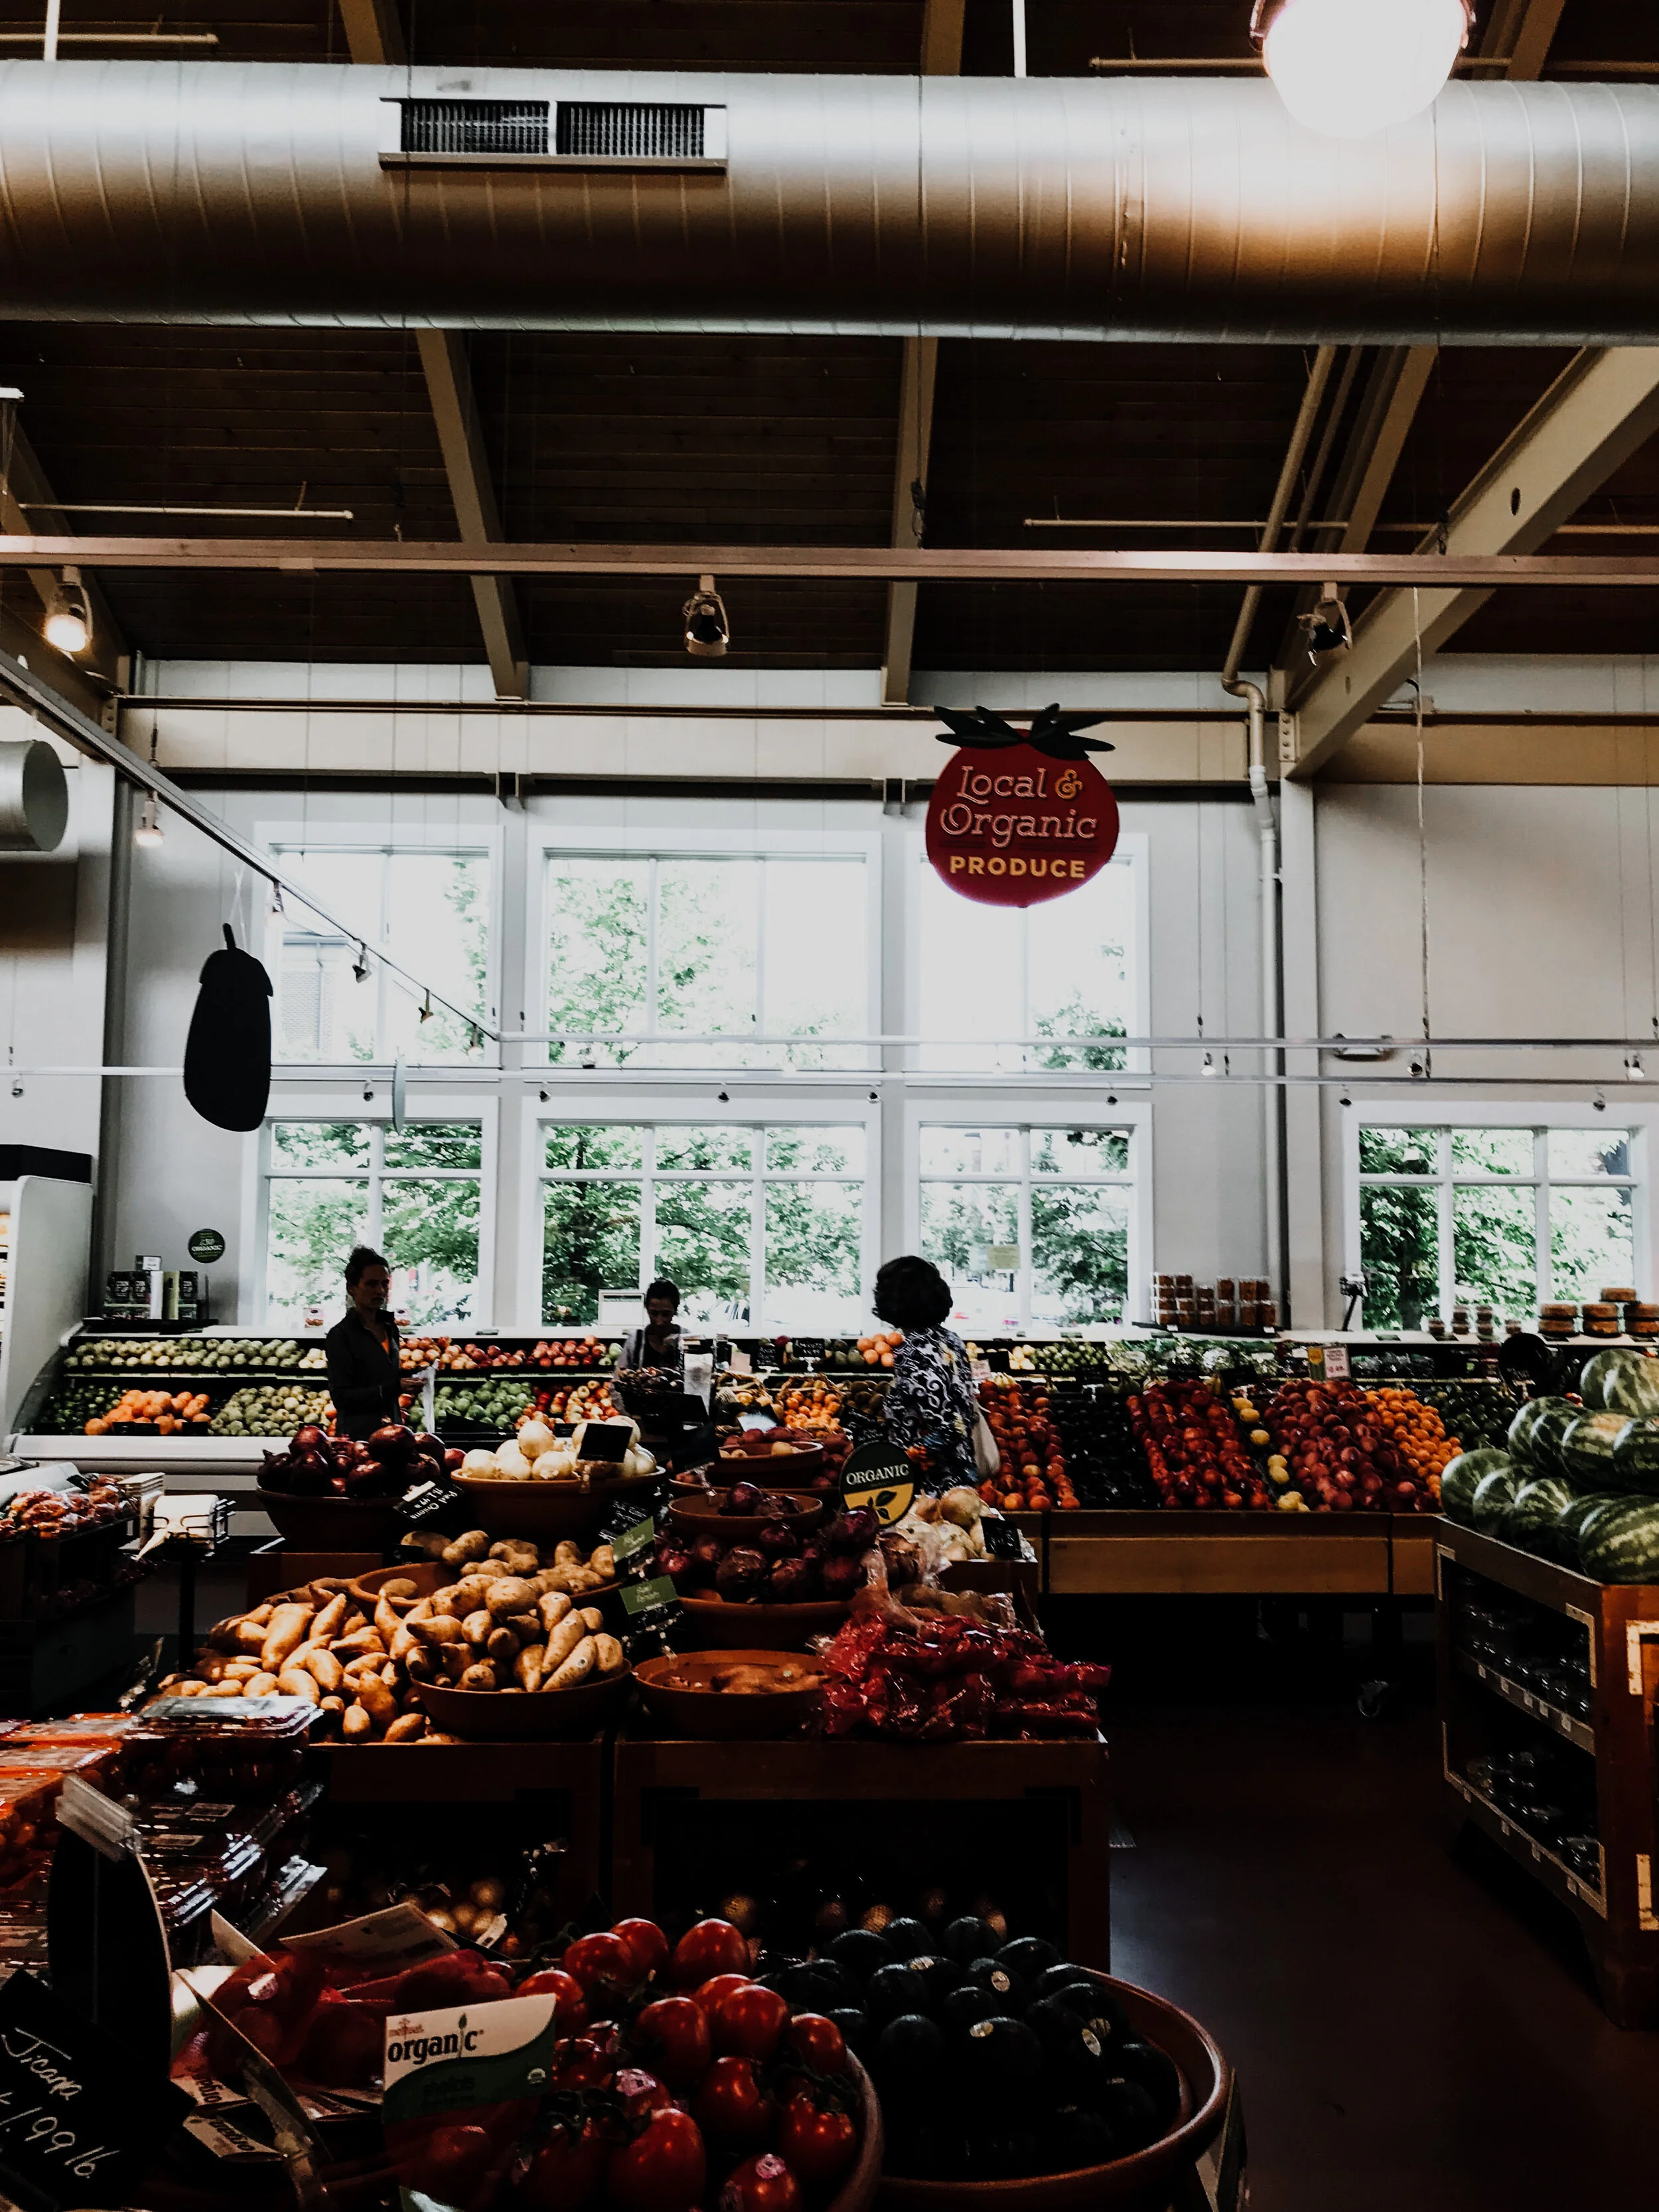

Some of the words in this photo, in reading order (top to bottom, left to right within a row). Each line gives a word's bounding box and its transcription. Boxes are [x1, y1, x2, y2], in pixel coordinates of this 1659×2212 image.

[956, 765, 1047, 805] Local
[1054, 769, 1084, 800] &
[939, 802, 1098, 848] Organic
[949, 855, 1086, 879] PRODUCE
[845, 1463, 910, 1486] ORGANIC
[388, 2016, 478, 2065] organic
